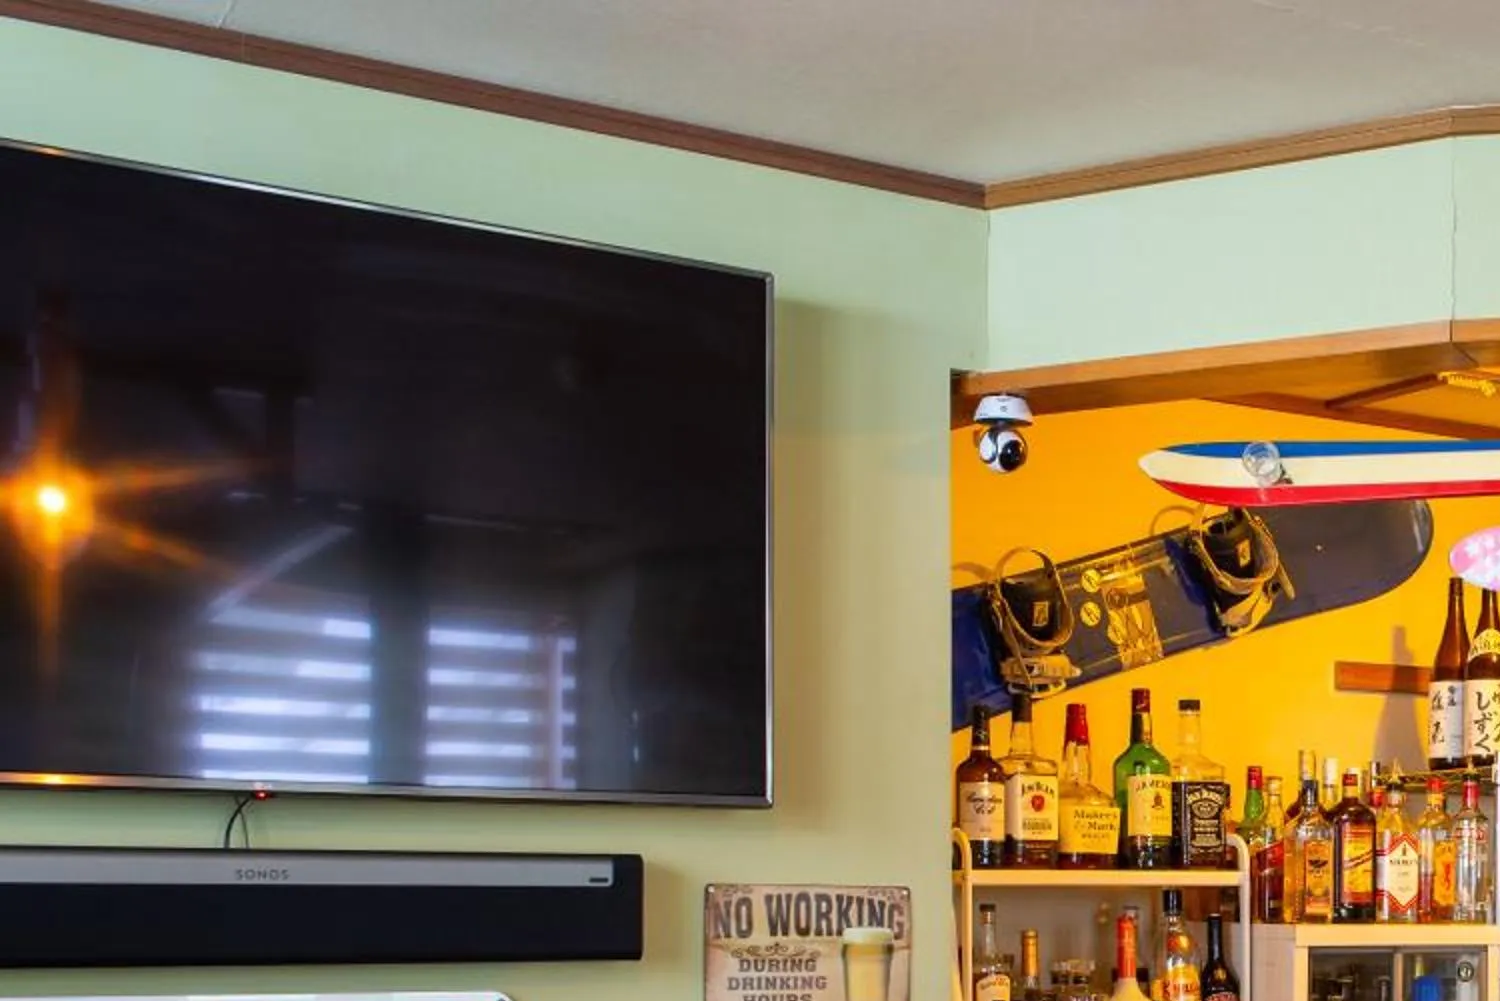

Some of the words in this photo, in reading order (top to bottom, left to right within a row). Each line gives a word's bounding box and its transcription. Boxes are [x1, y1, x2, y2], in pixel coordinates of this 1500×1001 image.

[235, 868, 291, 881] SONOS
[712, 896, 754, 940] NO
[764, 891, 905, 940] WORKING
[738, 957, 817, 973] DURING
[727, 975, 827, 991] DRINKING
